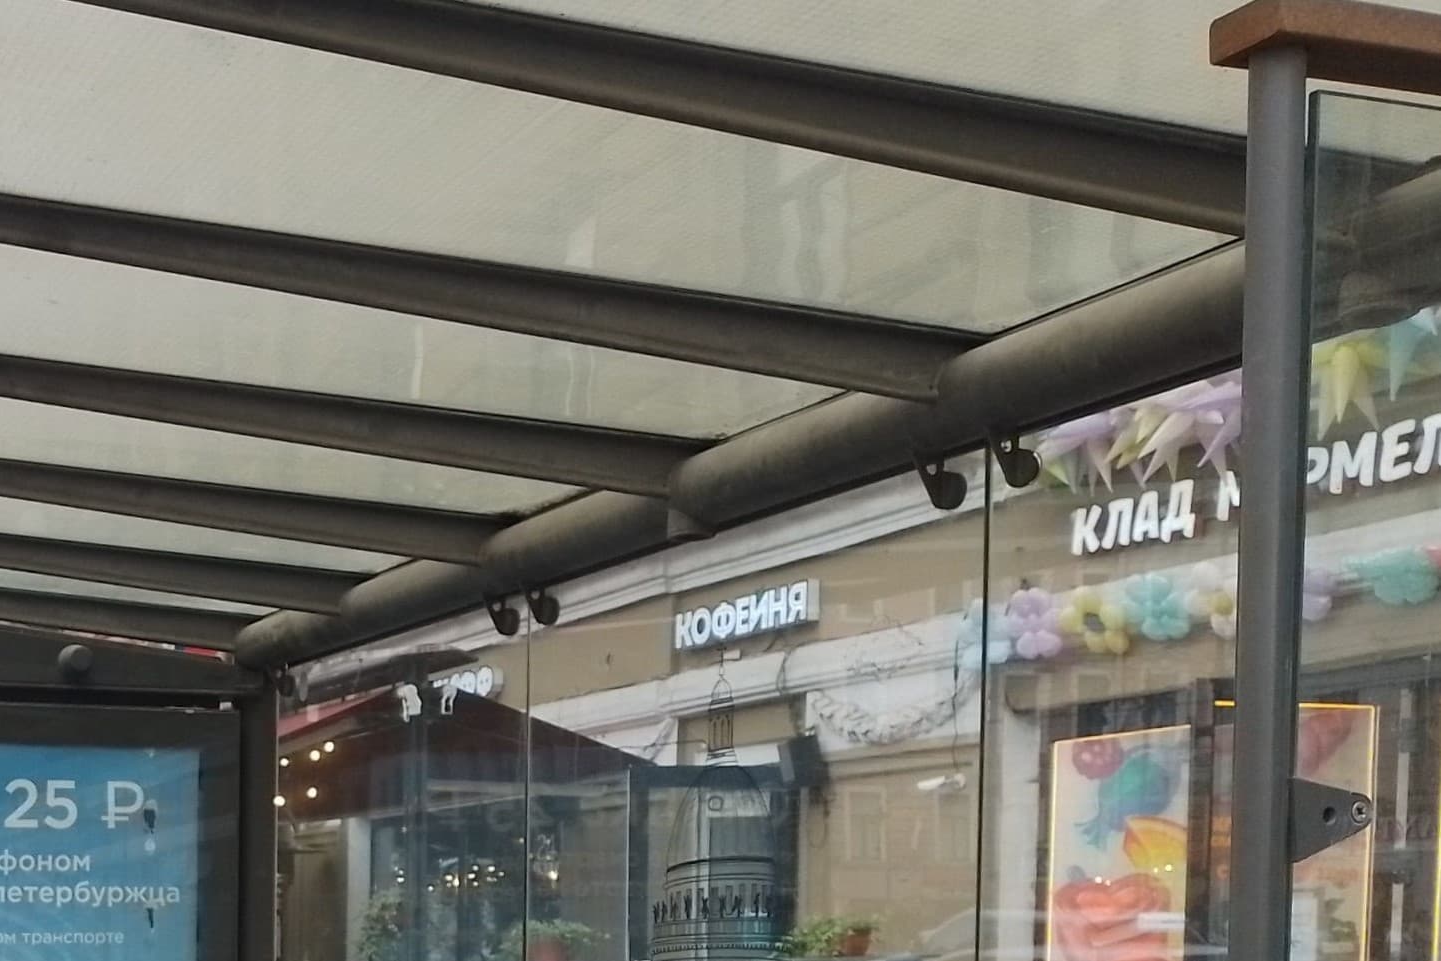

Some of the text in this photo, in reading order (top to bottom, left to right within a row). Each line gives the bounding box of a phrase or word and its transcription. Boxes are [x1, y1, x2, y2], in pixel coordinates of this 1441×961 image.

[1070, 478, 1196, 556] КЛАД
[3, 778, 78, 830] 25
[22, 929, 125, 947] транспорте
